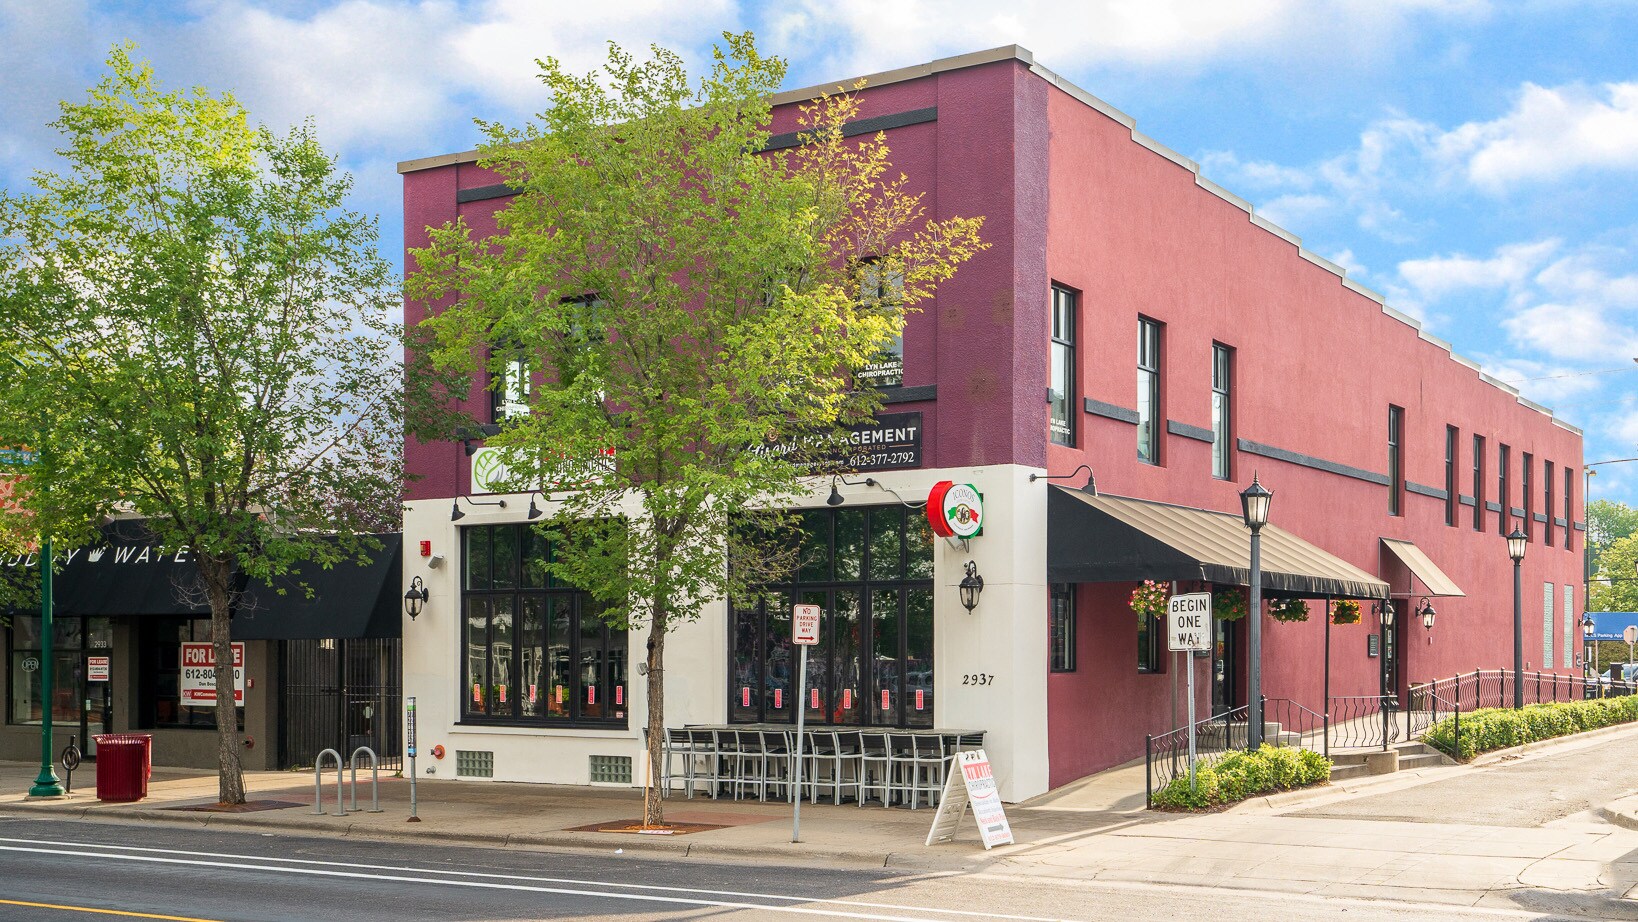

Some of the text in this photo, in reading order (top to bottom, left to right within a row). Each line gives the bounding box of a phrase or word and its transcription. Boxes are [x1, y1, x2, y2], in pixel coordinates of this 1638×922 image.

[880, 361, 898, 369] LAKE
[857, 368, 903, 379] CHIROPRACTIC
[849, 451, 915, 467] 612-377-2792
[1172, 598, 1207, 613] BEGIN
[1178, 615, 1202, 628] ONE
[94, 640, 107, 648] 2933
[185, 648, 207, 663] FOR
[185, 669, 240, 679] 612-8040
[962, 673, 994, 686] 2937
